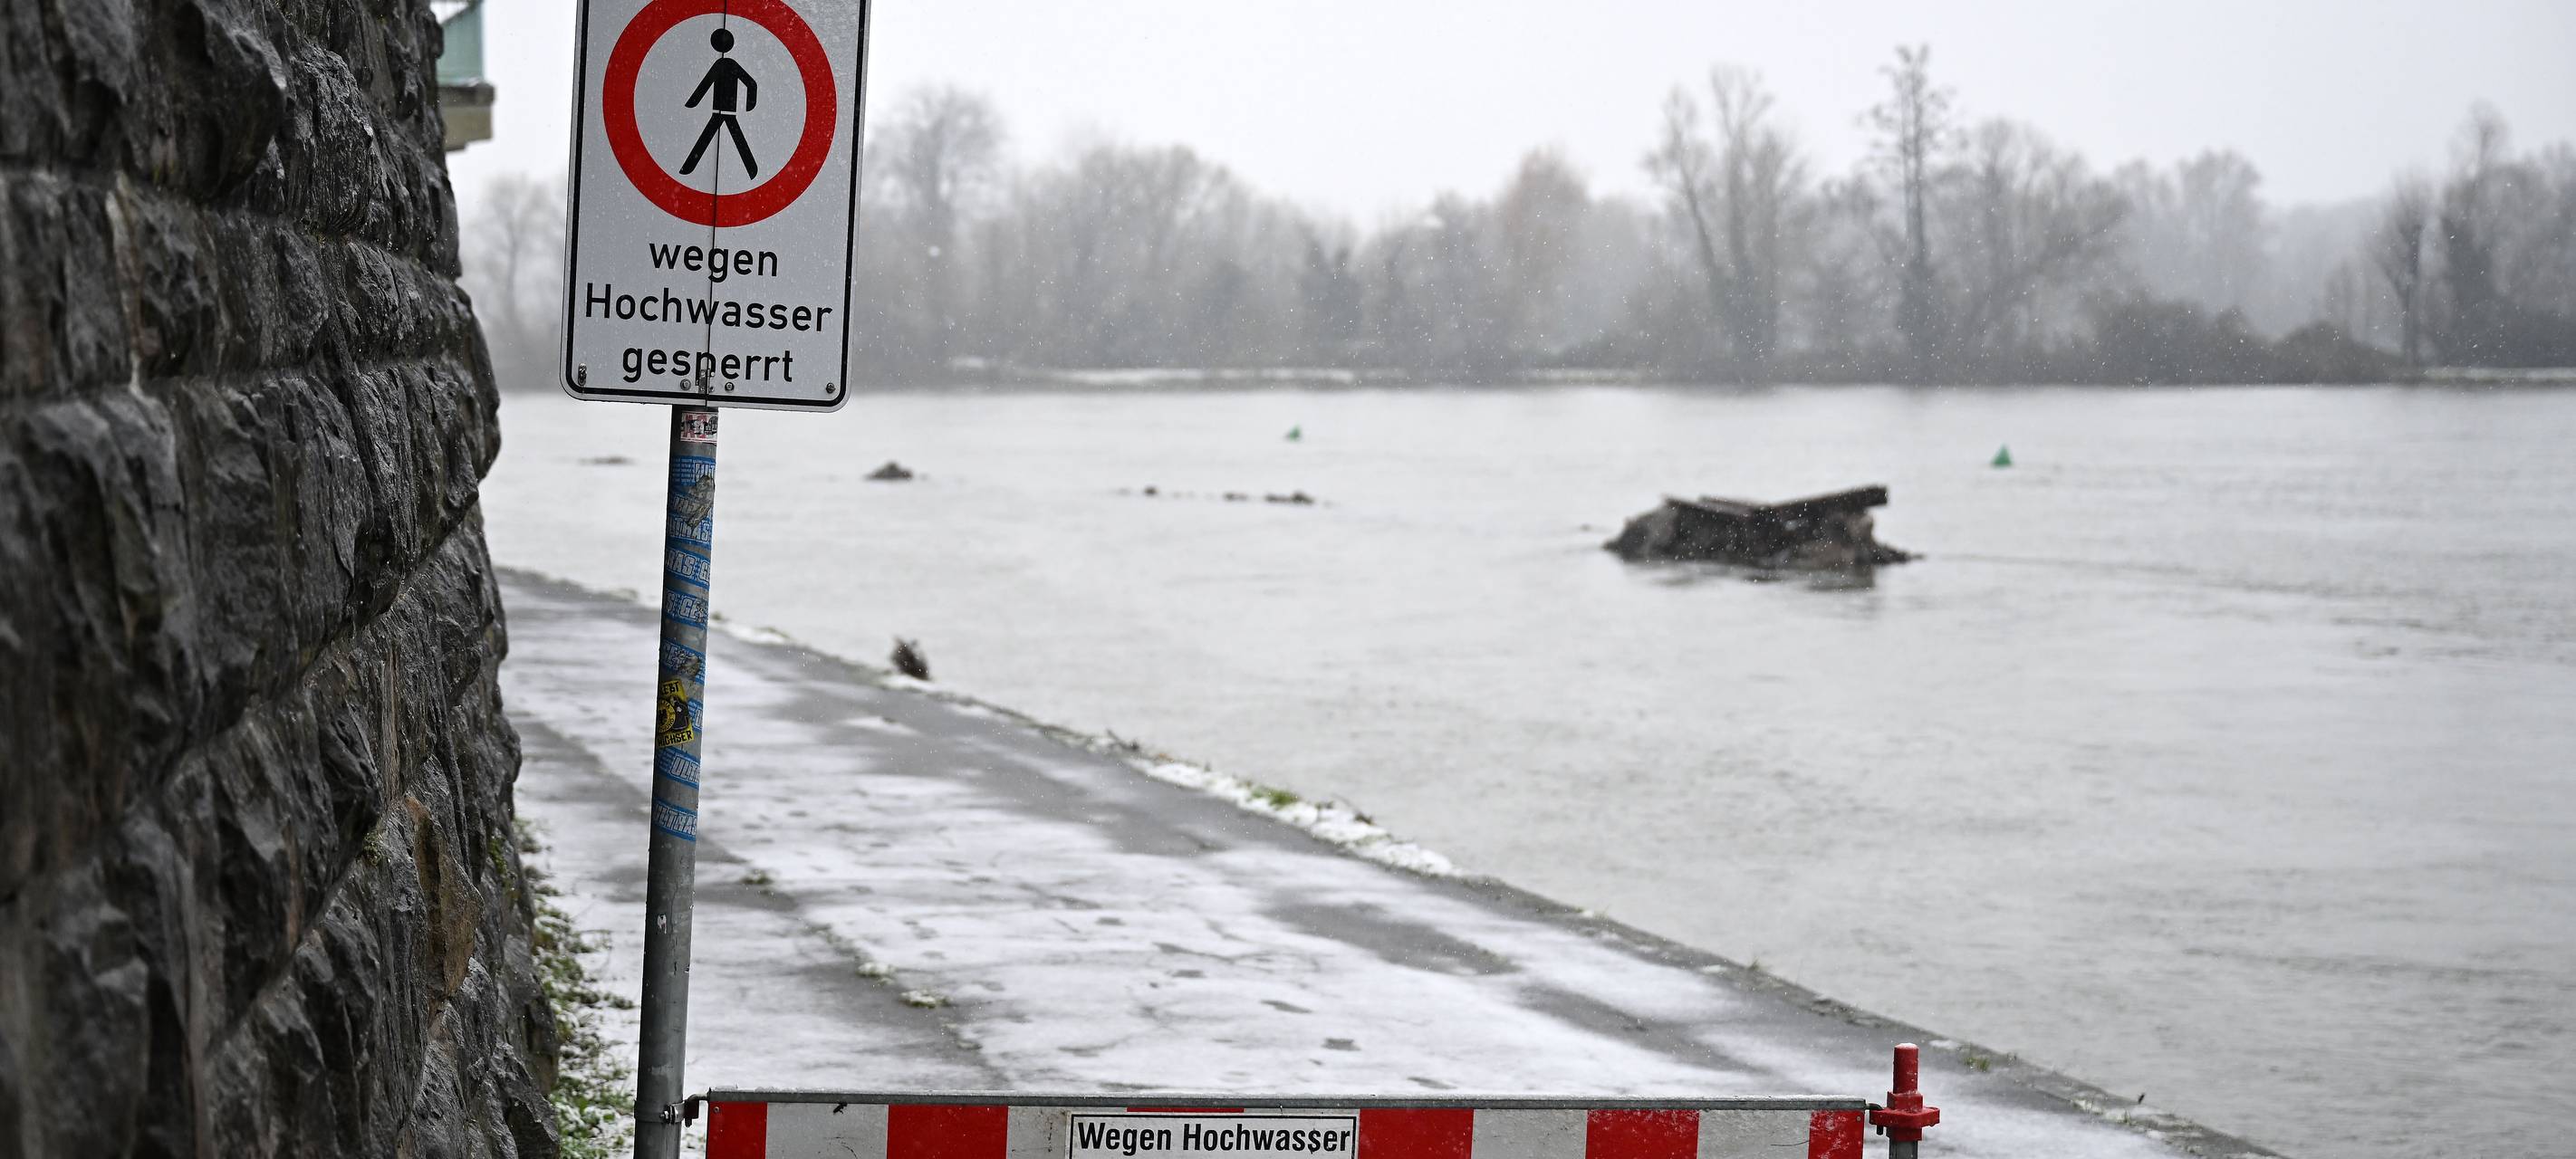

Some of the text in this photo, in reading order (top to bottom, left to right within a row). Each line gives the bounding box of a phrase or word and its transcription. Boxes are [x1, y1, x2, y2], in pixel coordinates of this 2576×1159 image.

[649, 243, 778, 283] wegen
[585, 283, 833, 332] Hochwasser
[622, 346, 793, 384] gesperrt
[1078, 1122, 1350, 1156] Wegen Hochwasser
